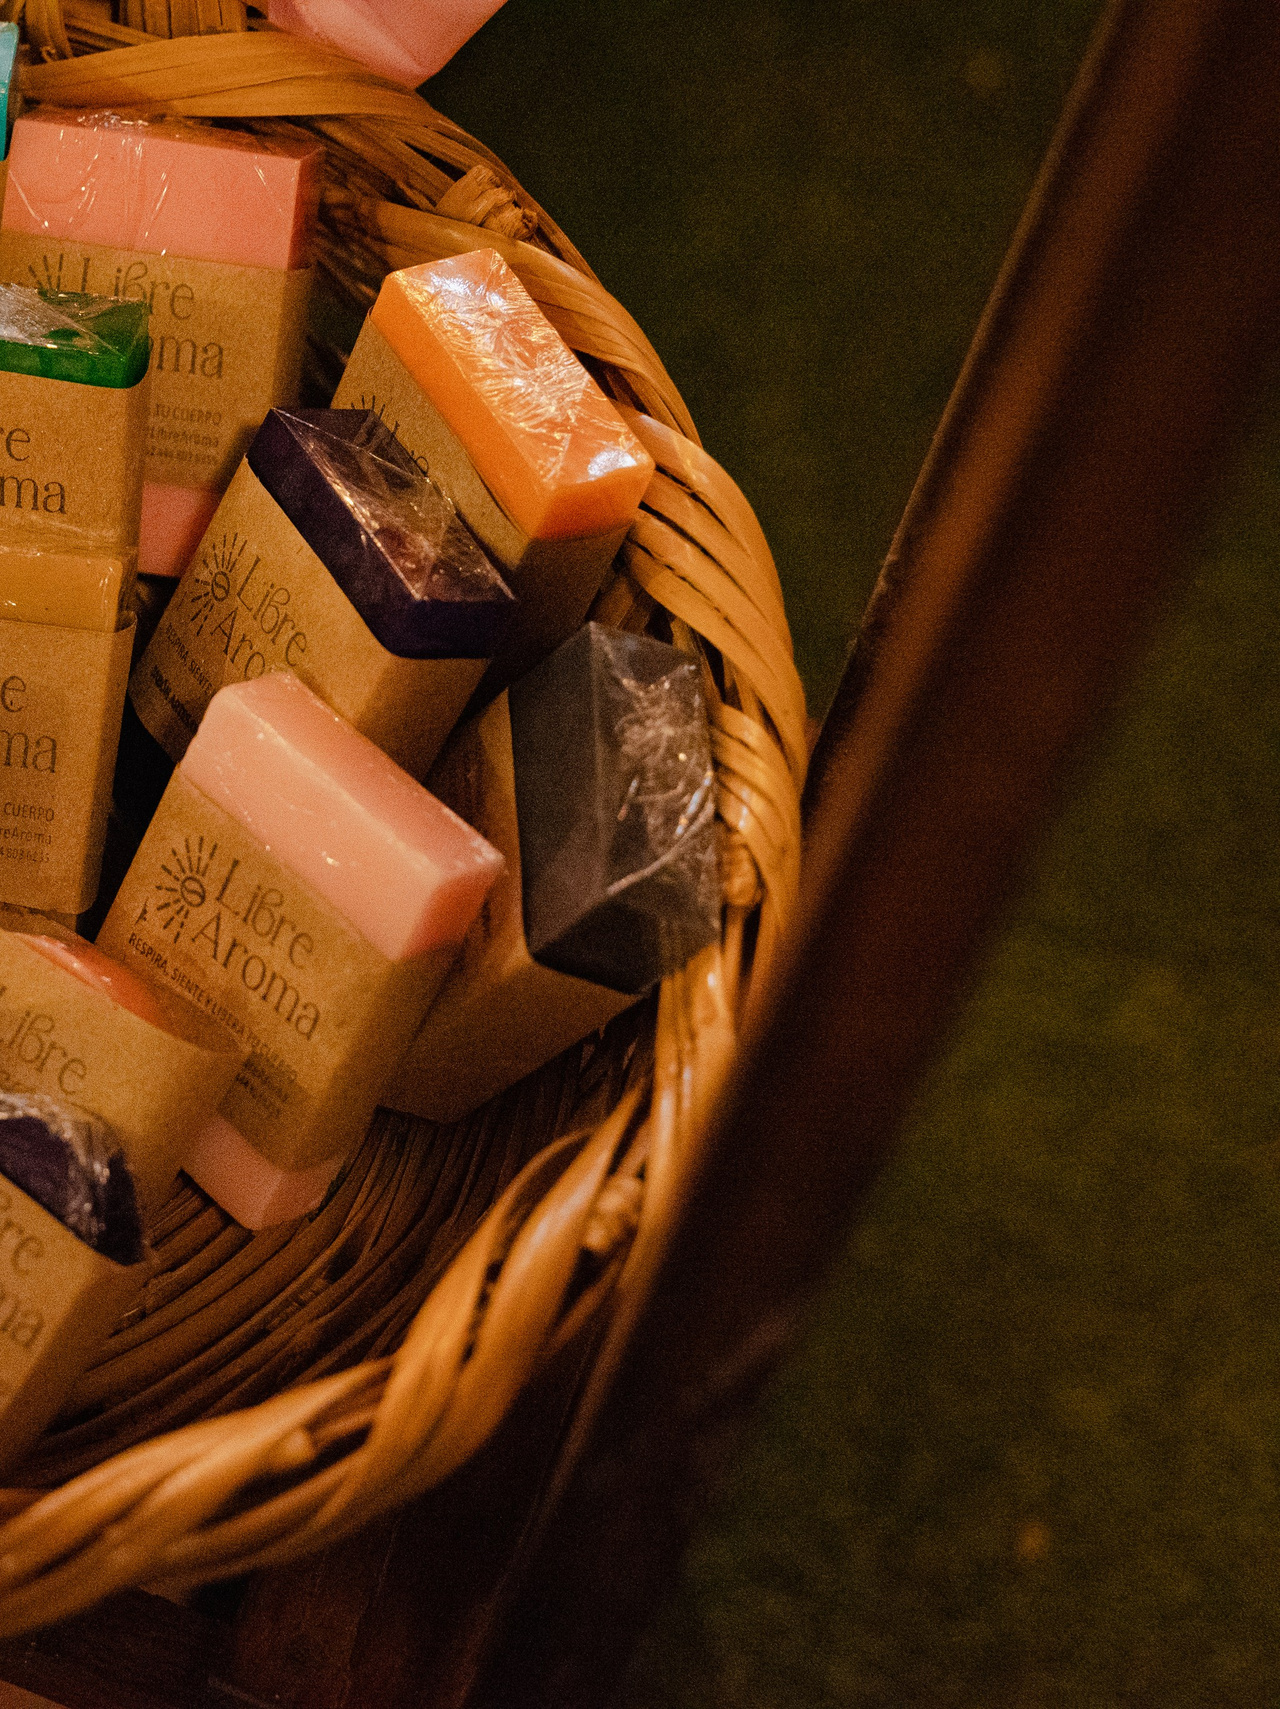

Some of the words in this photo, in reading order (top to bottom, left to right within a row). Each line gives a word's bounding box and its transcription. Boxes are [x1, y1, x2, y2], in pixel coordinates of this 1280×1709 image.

[210, 606, 266, 681] Aro
[237, 554, 308, 667] Libre
[3, 802, 55, 822] CUERPO
[215, 858, 315, 970] Libre
[191, 911, 321, 1042] Aroma
